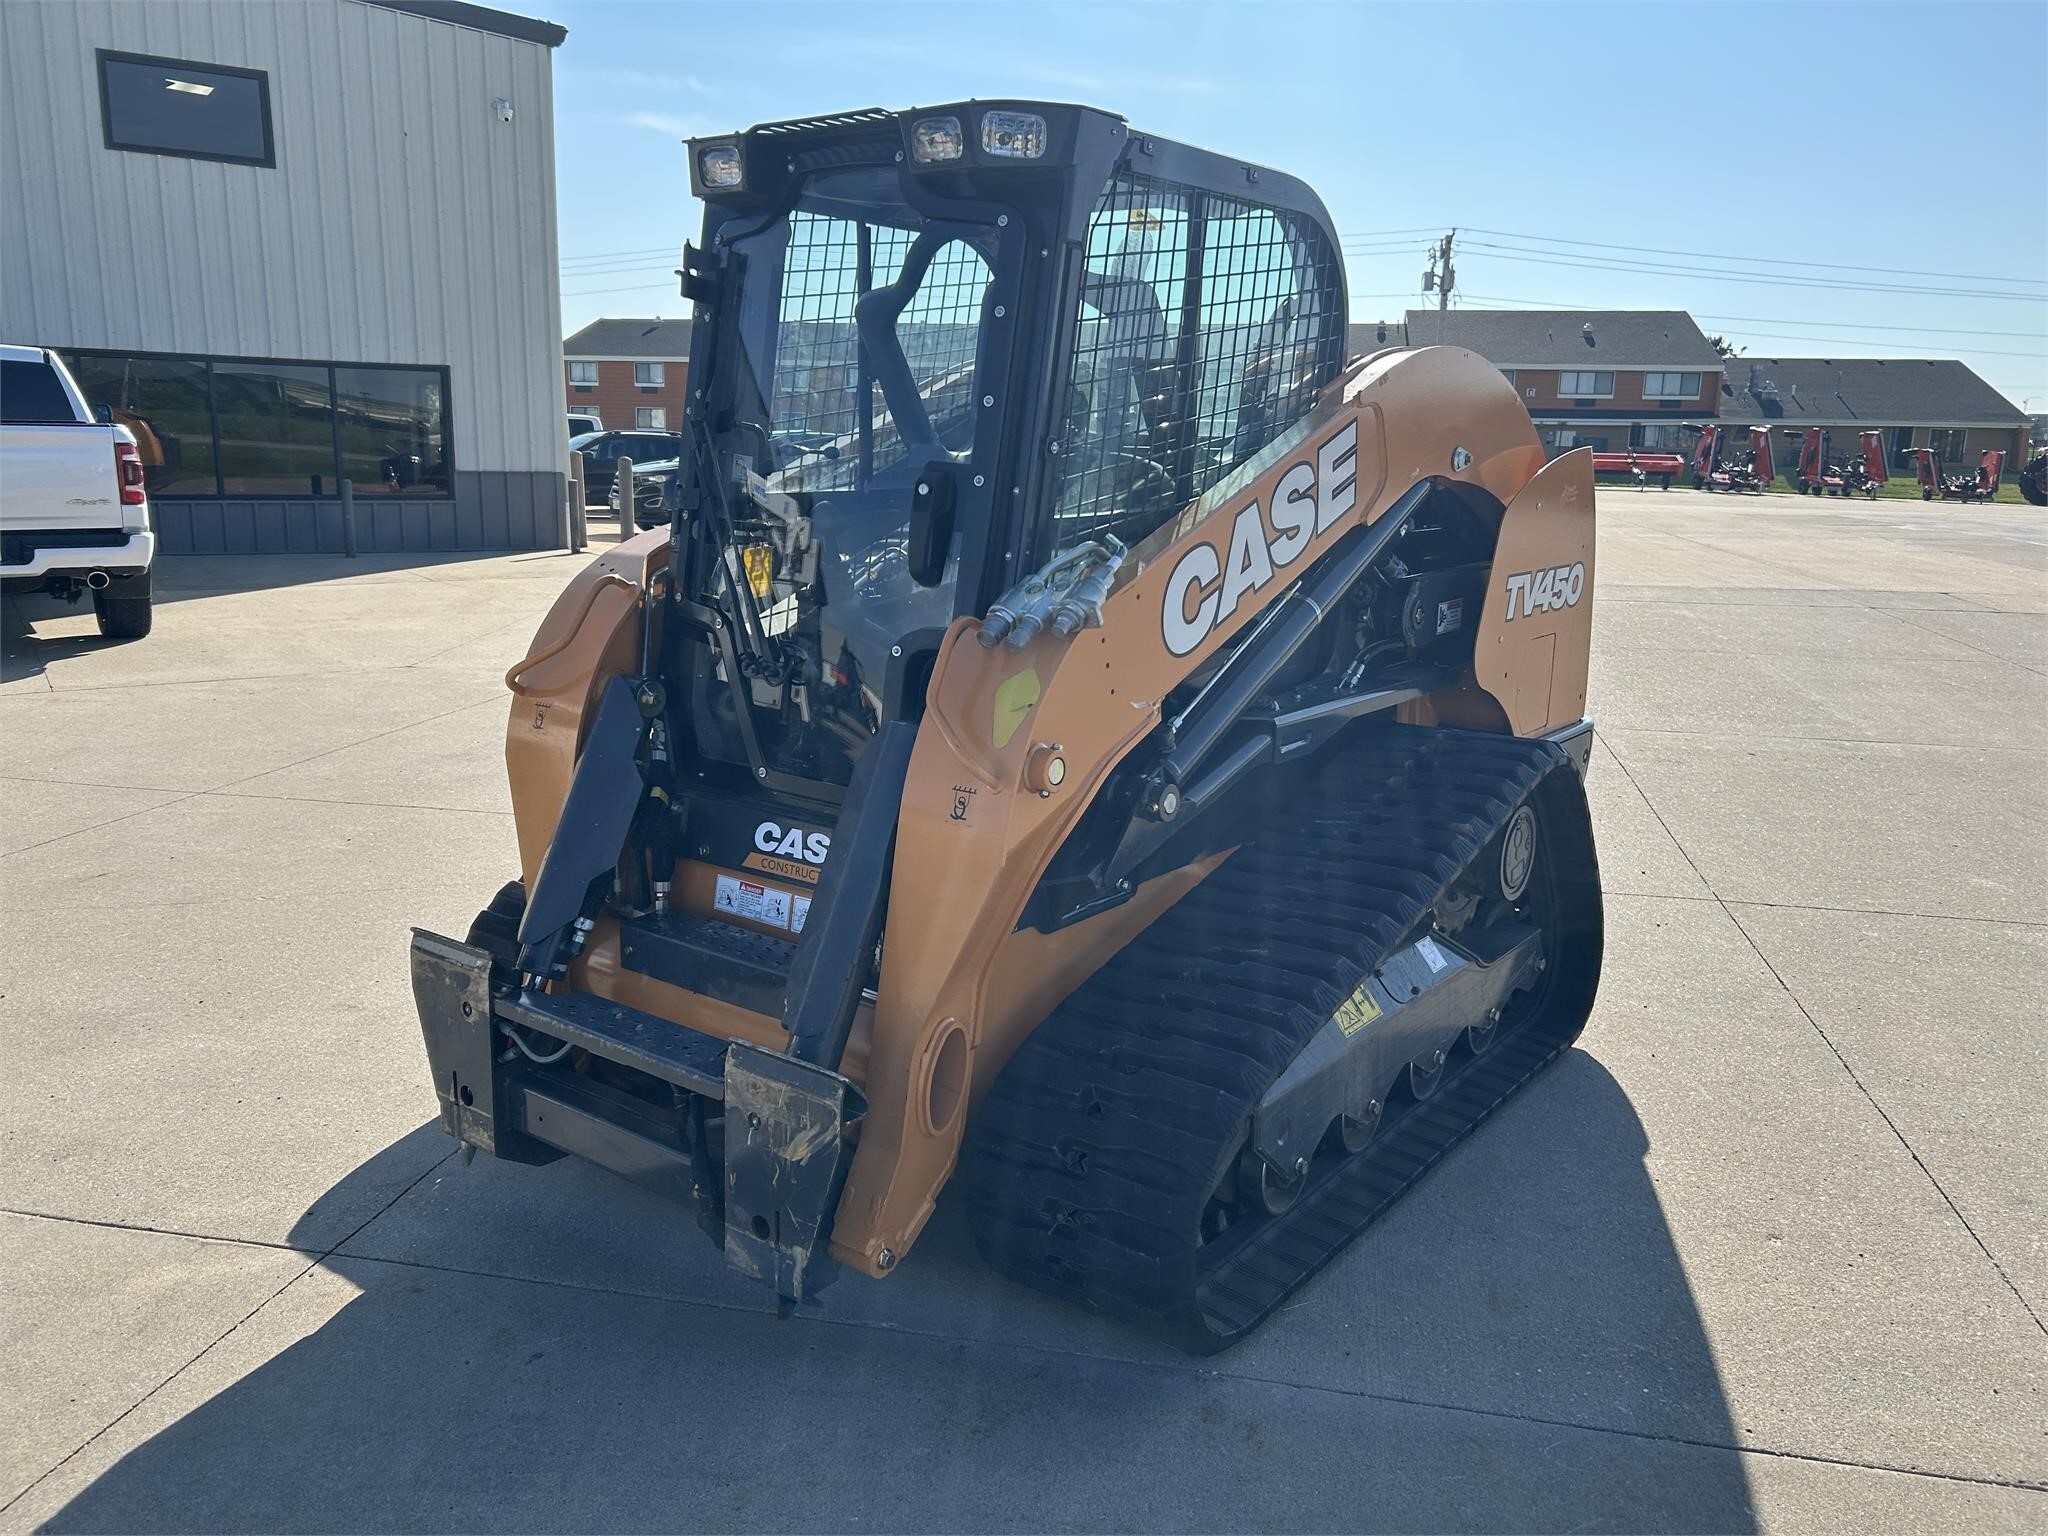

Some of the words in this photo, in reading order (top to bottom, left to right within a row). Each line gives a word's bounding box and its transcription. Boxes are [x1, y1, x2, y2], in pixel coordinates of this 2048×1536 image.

[1162, 416, 1358, 659] CASE
[1505, 561, 1585, 623] TV450
[754, 821, 831, 864] CAS
[760, 858, 820, 881] CONSTRUC
